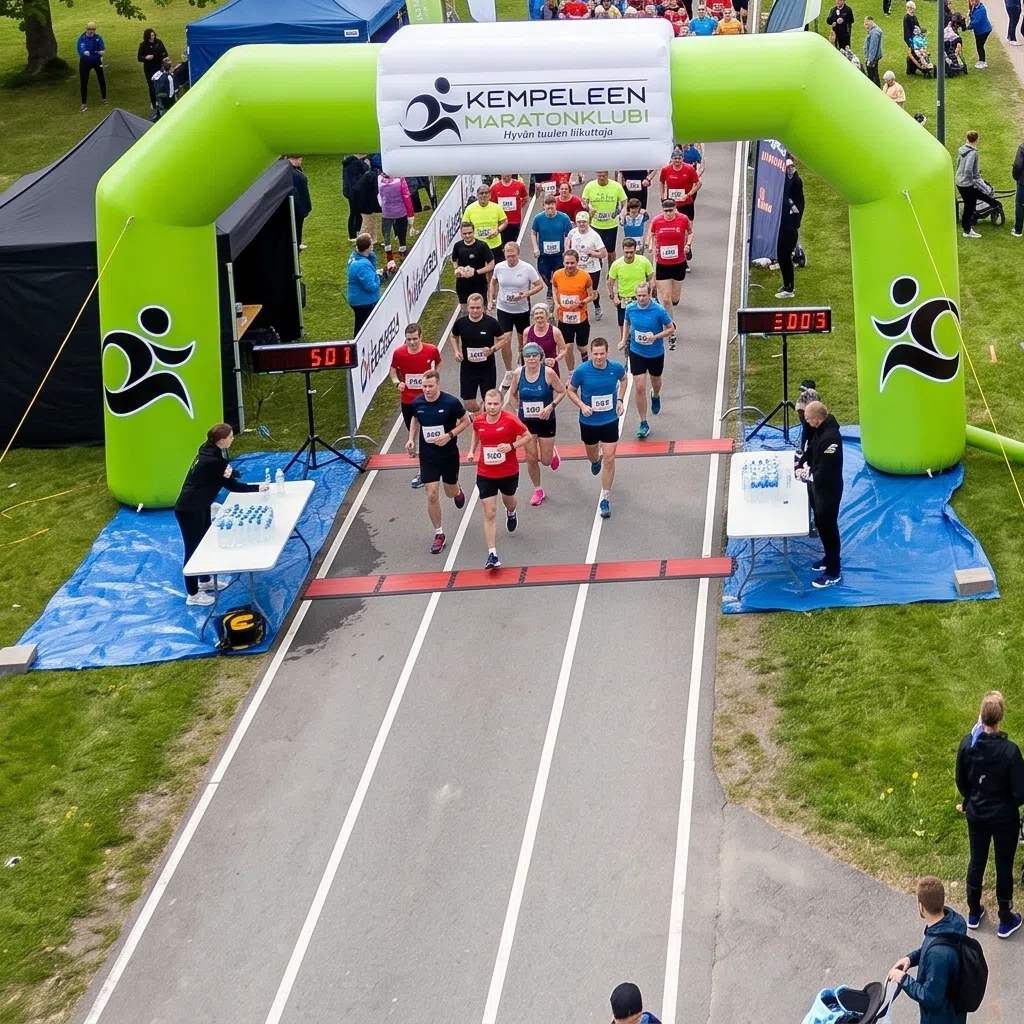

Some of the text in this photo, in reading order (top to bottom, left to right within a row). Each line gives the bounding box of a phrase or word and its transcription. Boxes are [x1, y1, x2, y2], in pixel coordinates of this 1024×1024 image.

[467, 86, 646, 109] KEMPELEEN
[464, 109, 649, 129] MARATONKLUBI
[537, 129, 568, 139] tuulen
[570, 128, 613, 138] liikuttaja
